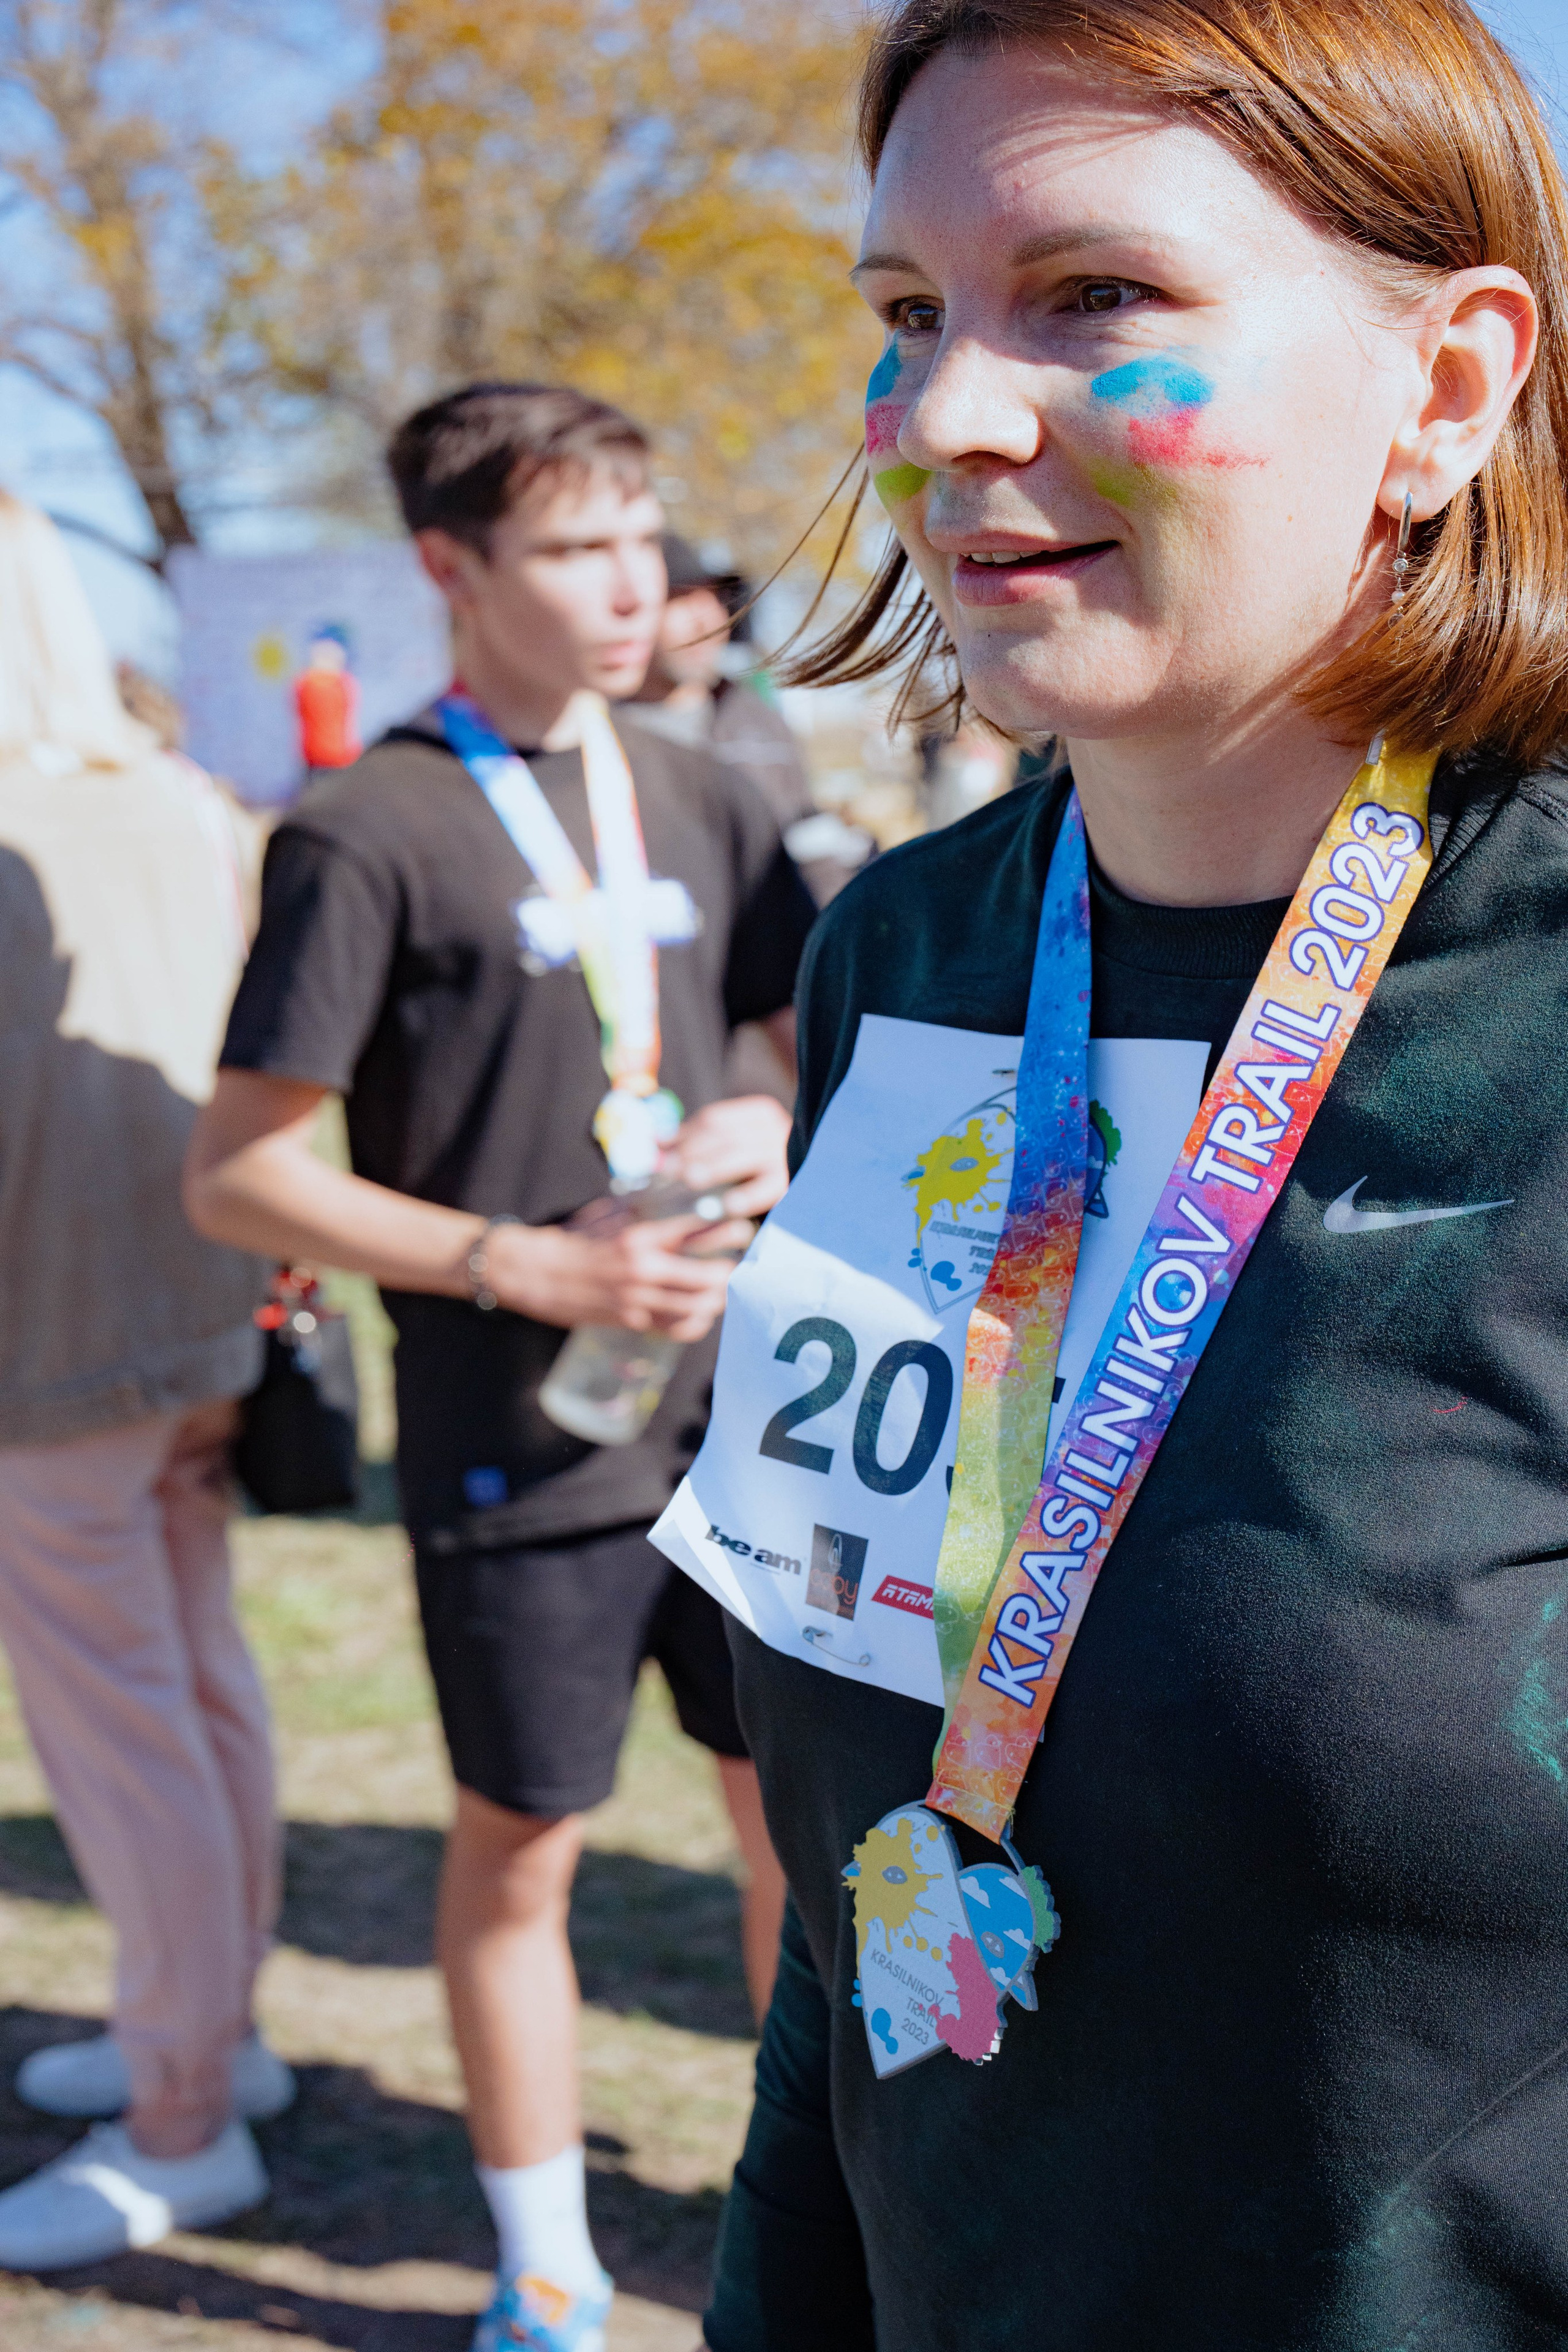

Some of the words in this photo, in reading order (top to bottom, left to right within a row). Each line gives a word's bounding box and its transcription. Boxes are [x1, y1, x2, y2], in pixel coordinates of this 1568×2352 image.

[979, 1194, 1234, 1708] KRASILNIKOV
[1189, 999, 1342, 1194] TRAIL
[1289, 802, 1425, 992] 2023
[758, 1316, 1066, 1498] 20
[881, 1583, 935, 1611] ATAM
[870, 1948, 944, 2006] KRASILNIKOV
[901, 2018, 929, 2045] 2023
